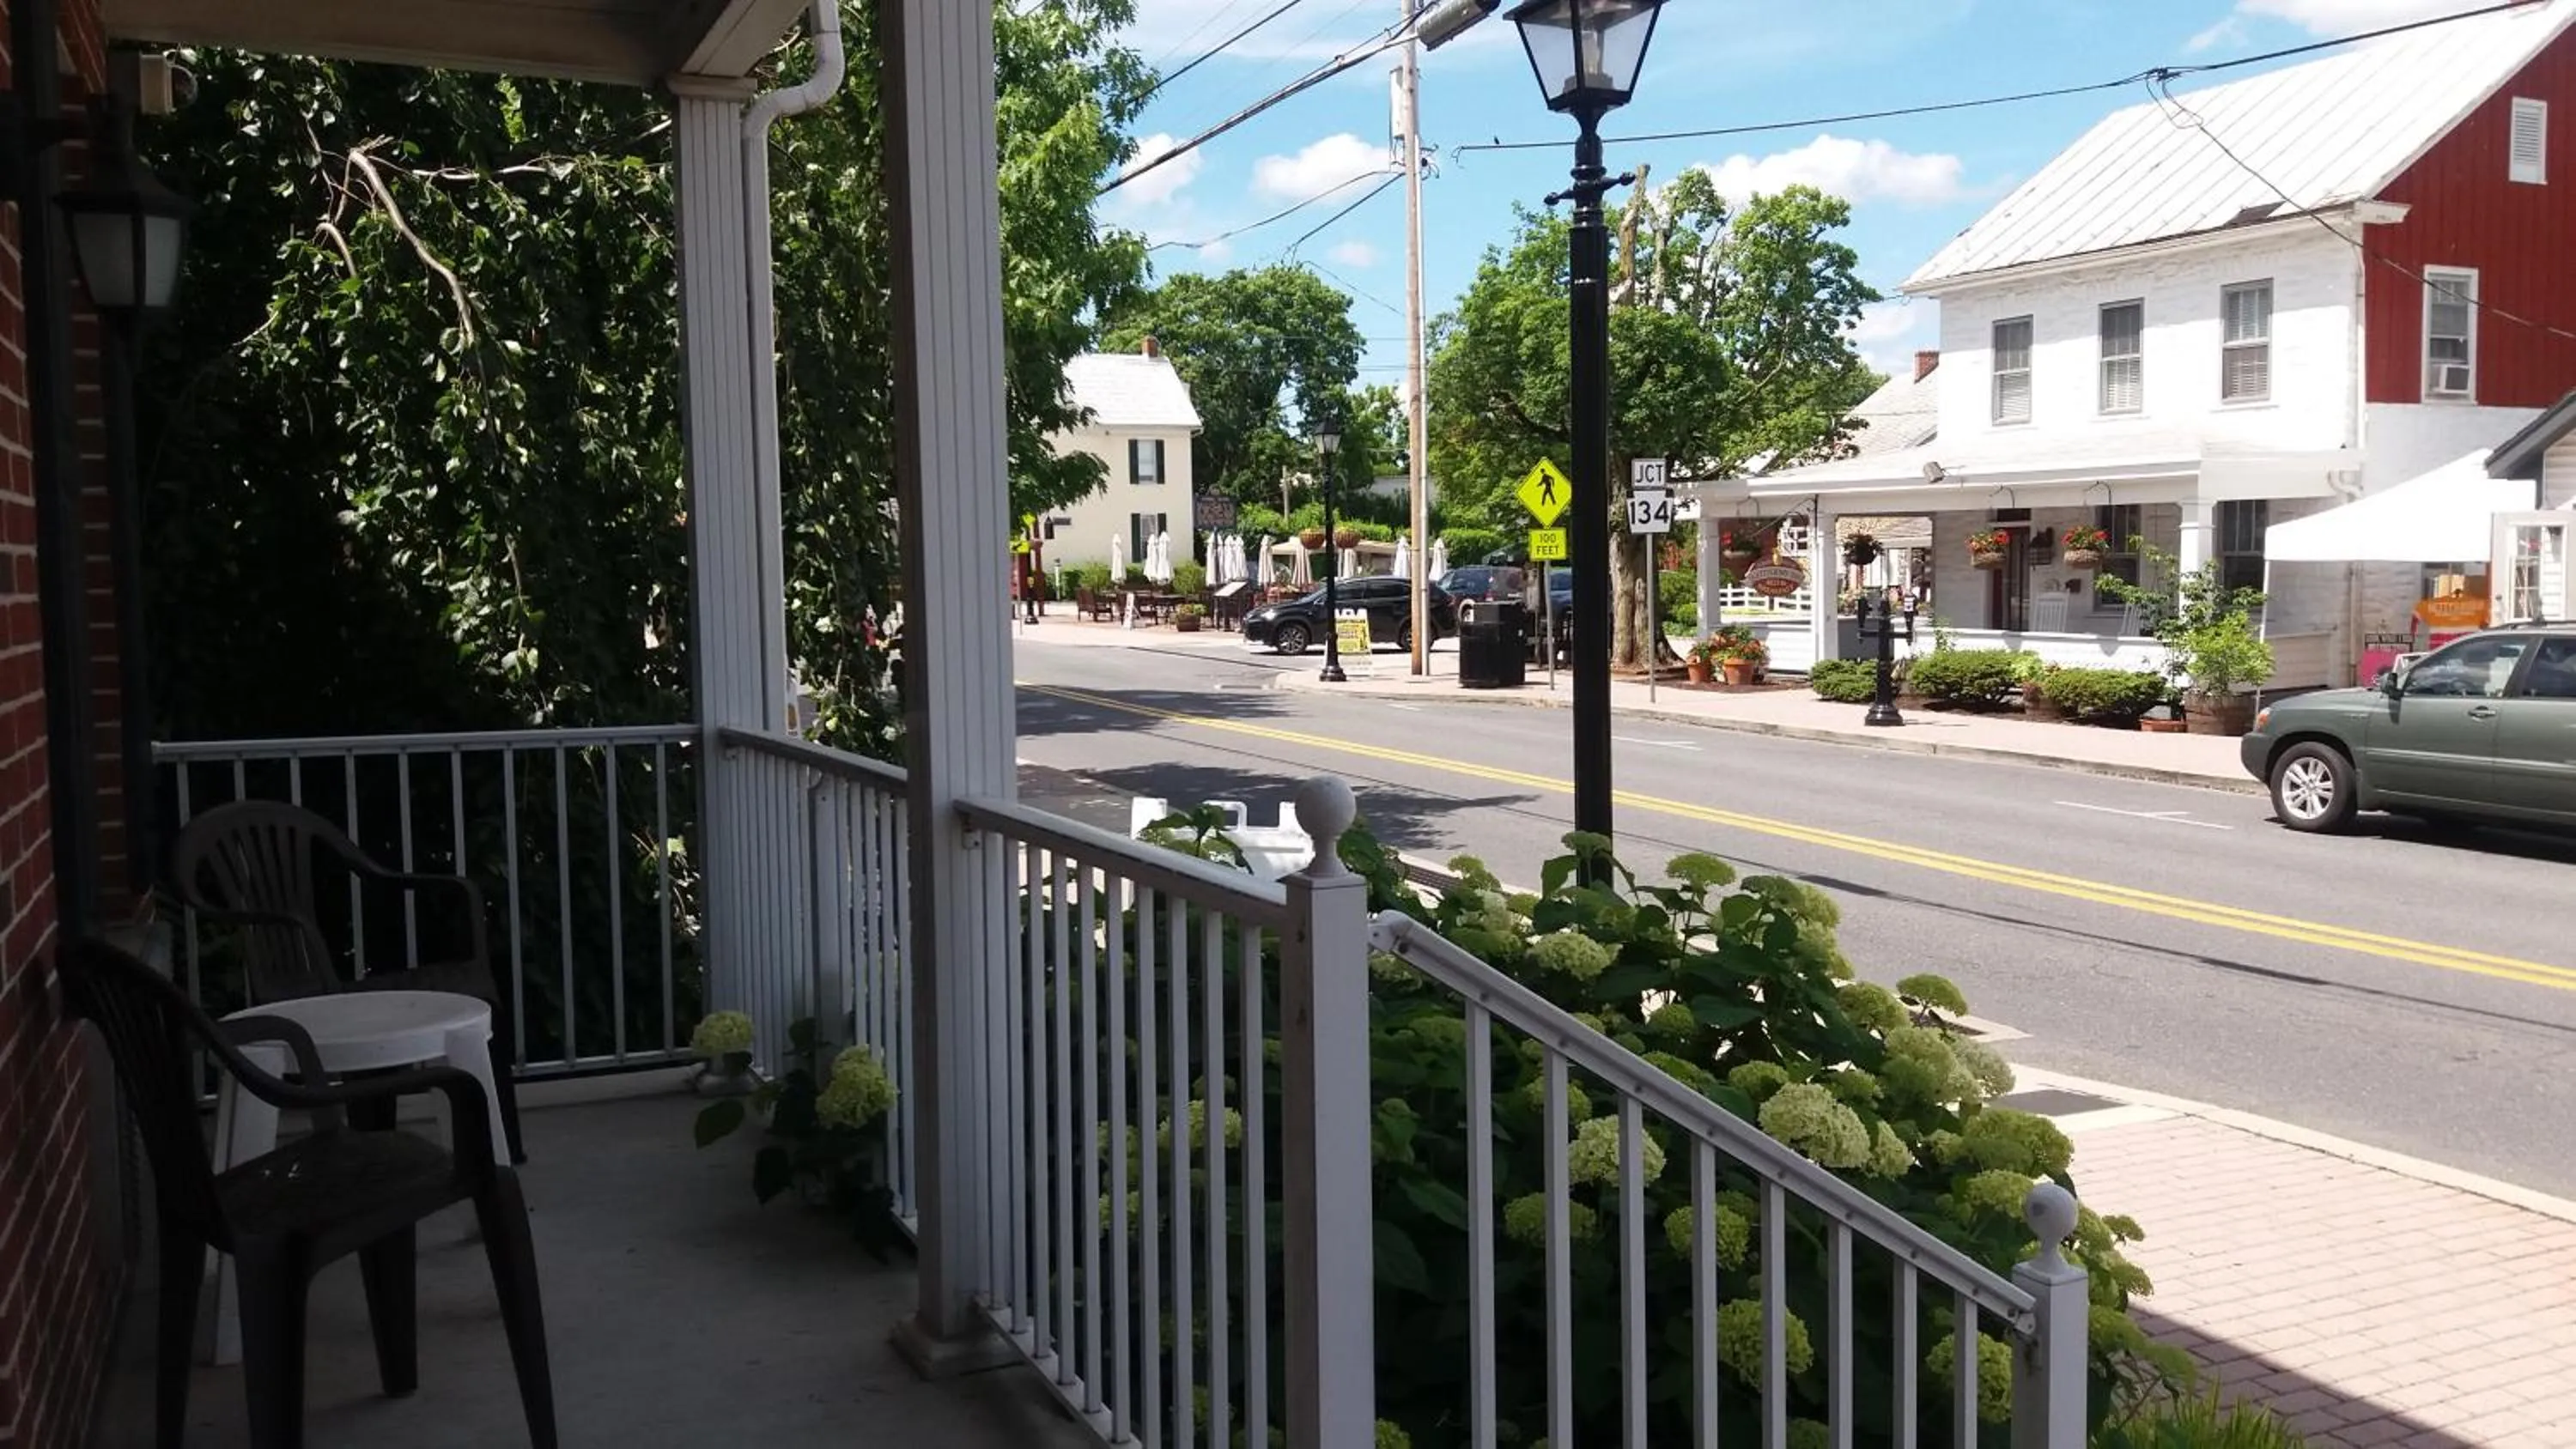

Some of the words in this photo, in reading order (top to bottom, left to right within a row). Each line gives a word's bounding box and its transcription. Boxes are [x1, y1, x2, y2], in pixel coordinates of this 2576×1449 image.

[1635, 464, 1663, 482] JCT
[1630, 500, 1669, 524] 134
[1539, 533, 1557, 543] 100
[1536, 545, 1559, 555] FEET
